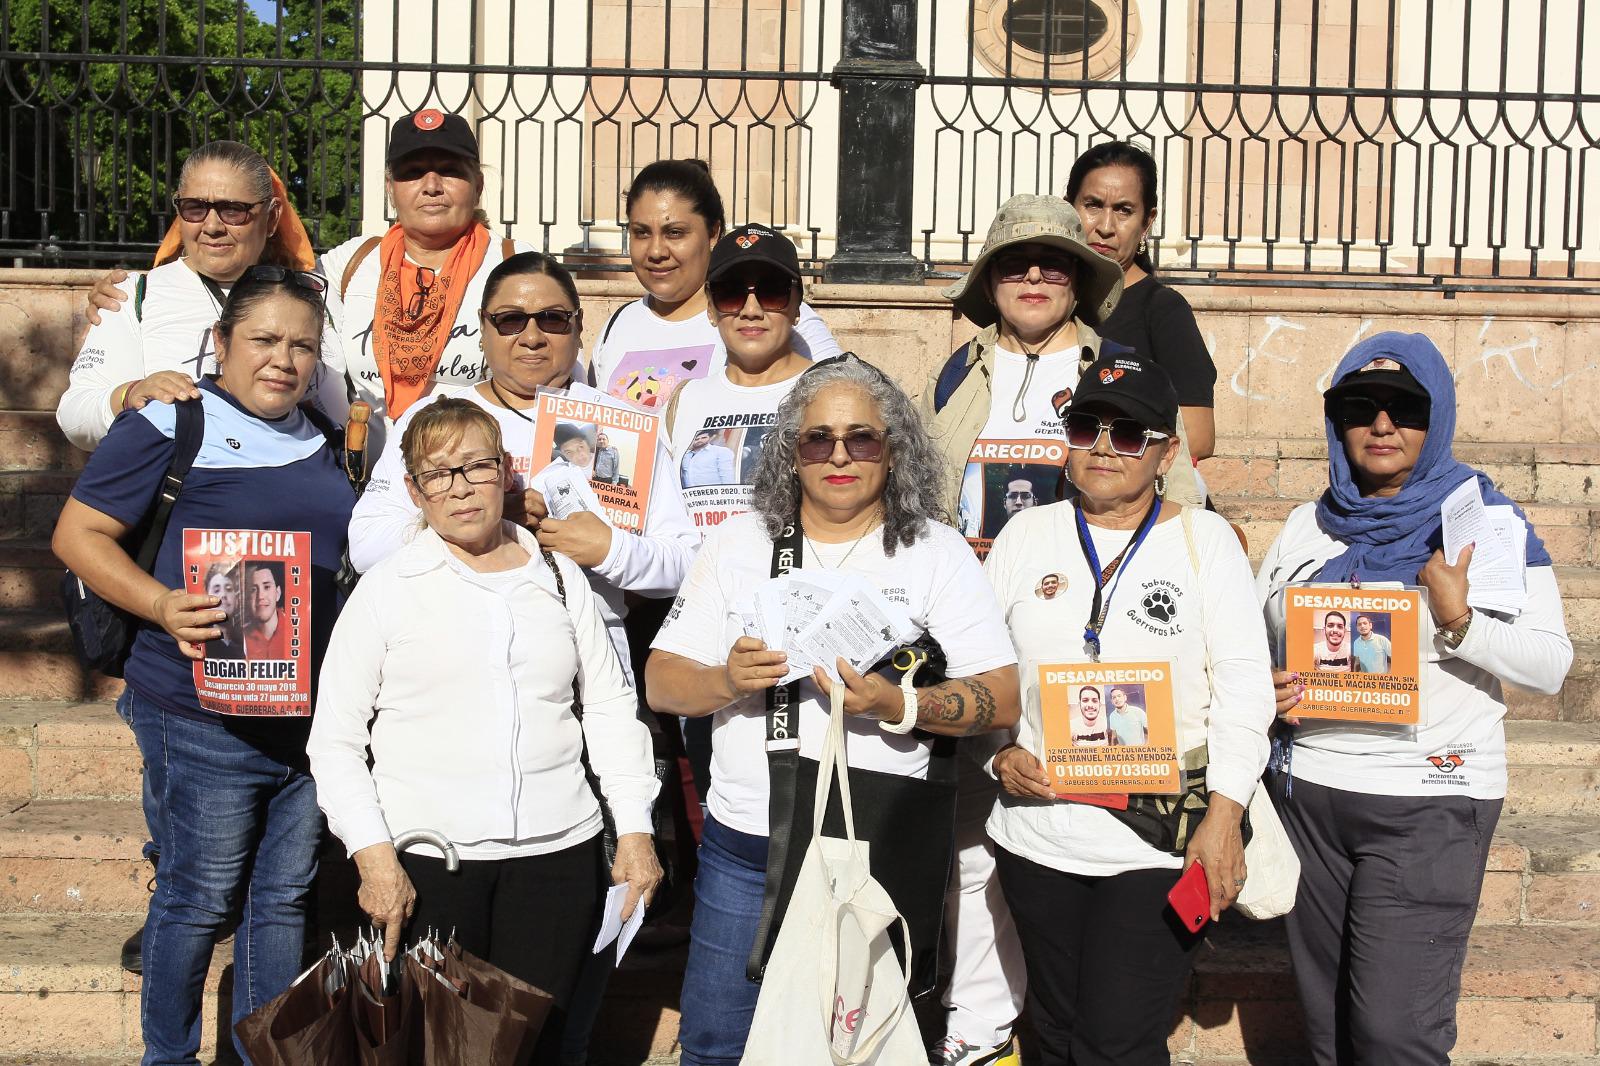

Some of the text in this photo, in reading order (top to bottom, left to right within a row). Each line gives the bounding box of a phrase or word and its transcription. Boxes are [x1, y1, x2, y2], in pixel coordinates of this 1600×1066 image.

[546, 398, 653, 433] DESAPARECIDO
[970, 443, 1063, 461] ARECIDO
[689, 488, 719, 497] FEBRERO
[602, 495, 640, 510] IBARRA A.
[687, 500, 709, 508] ALFONSO
[602, 507, 640, 528] 3600
[694, 512, 704, 527] 01
[200, 531, 296, 557] JUSTICIA
[190, 564, 200, 585] NI
[291, 566, 300, 586] NI
[1141, 578, 1184, 598] Sabuesos
[1293, 594, 1412, 612] DESAPARECIDO
[290, 597, 300, 658] OLVIDO
[1126, 609, 1168, 637] Guerreras
[204, 659, 297, 680] EDGAR FELIPE
[1046, 669, 1164, 684] DESAPARECIDO
[204, 680, 297, 692] Desapareció 30 mayo 2018
[1310, 679, 1344, 688] MANUEL
[1378, 683, 1419, 692] MENDOZA
[230, 693, 242, 701] sin
[243, 693, 258, 702] vida
[260, 693, 268, 702] 27
[269, 693, 289, 703] junio
[290, 693, 308, 702] 2018
[774, 686, 789, 740] KENZO
[1069, 754, 1102, 762] MANUEL
[1136, 752, 1178, 760] MENDOZA
[1055, 763, 1170, 778] 018006703600
